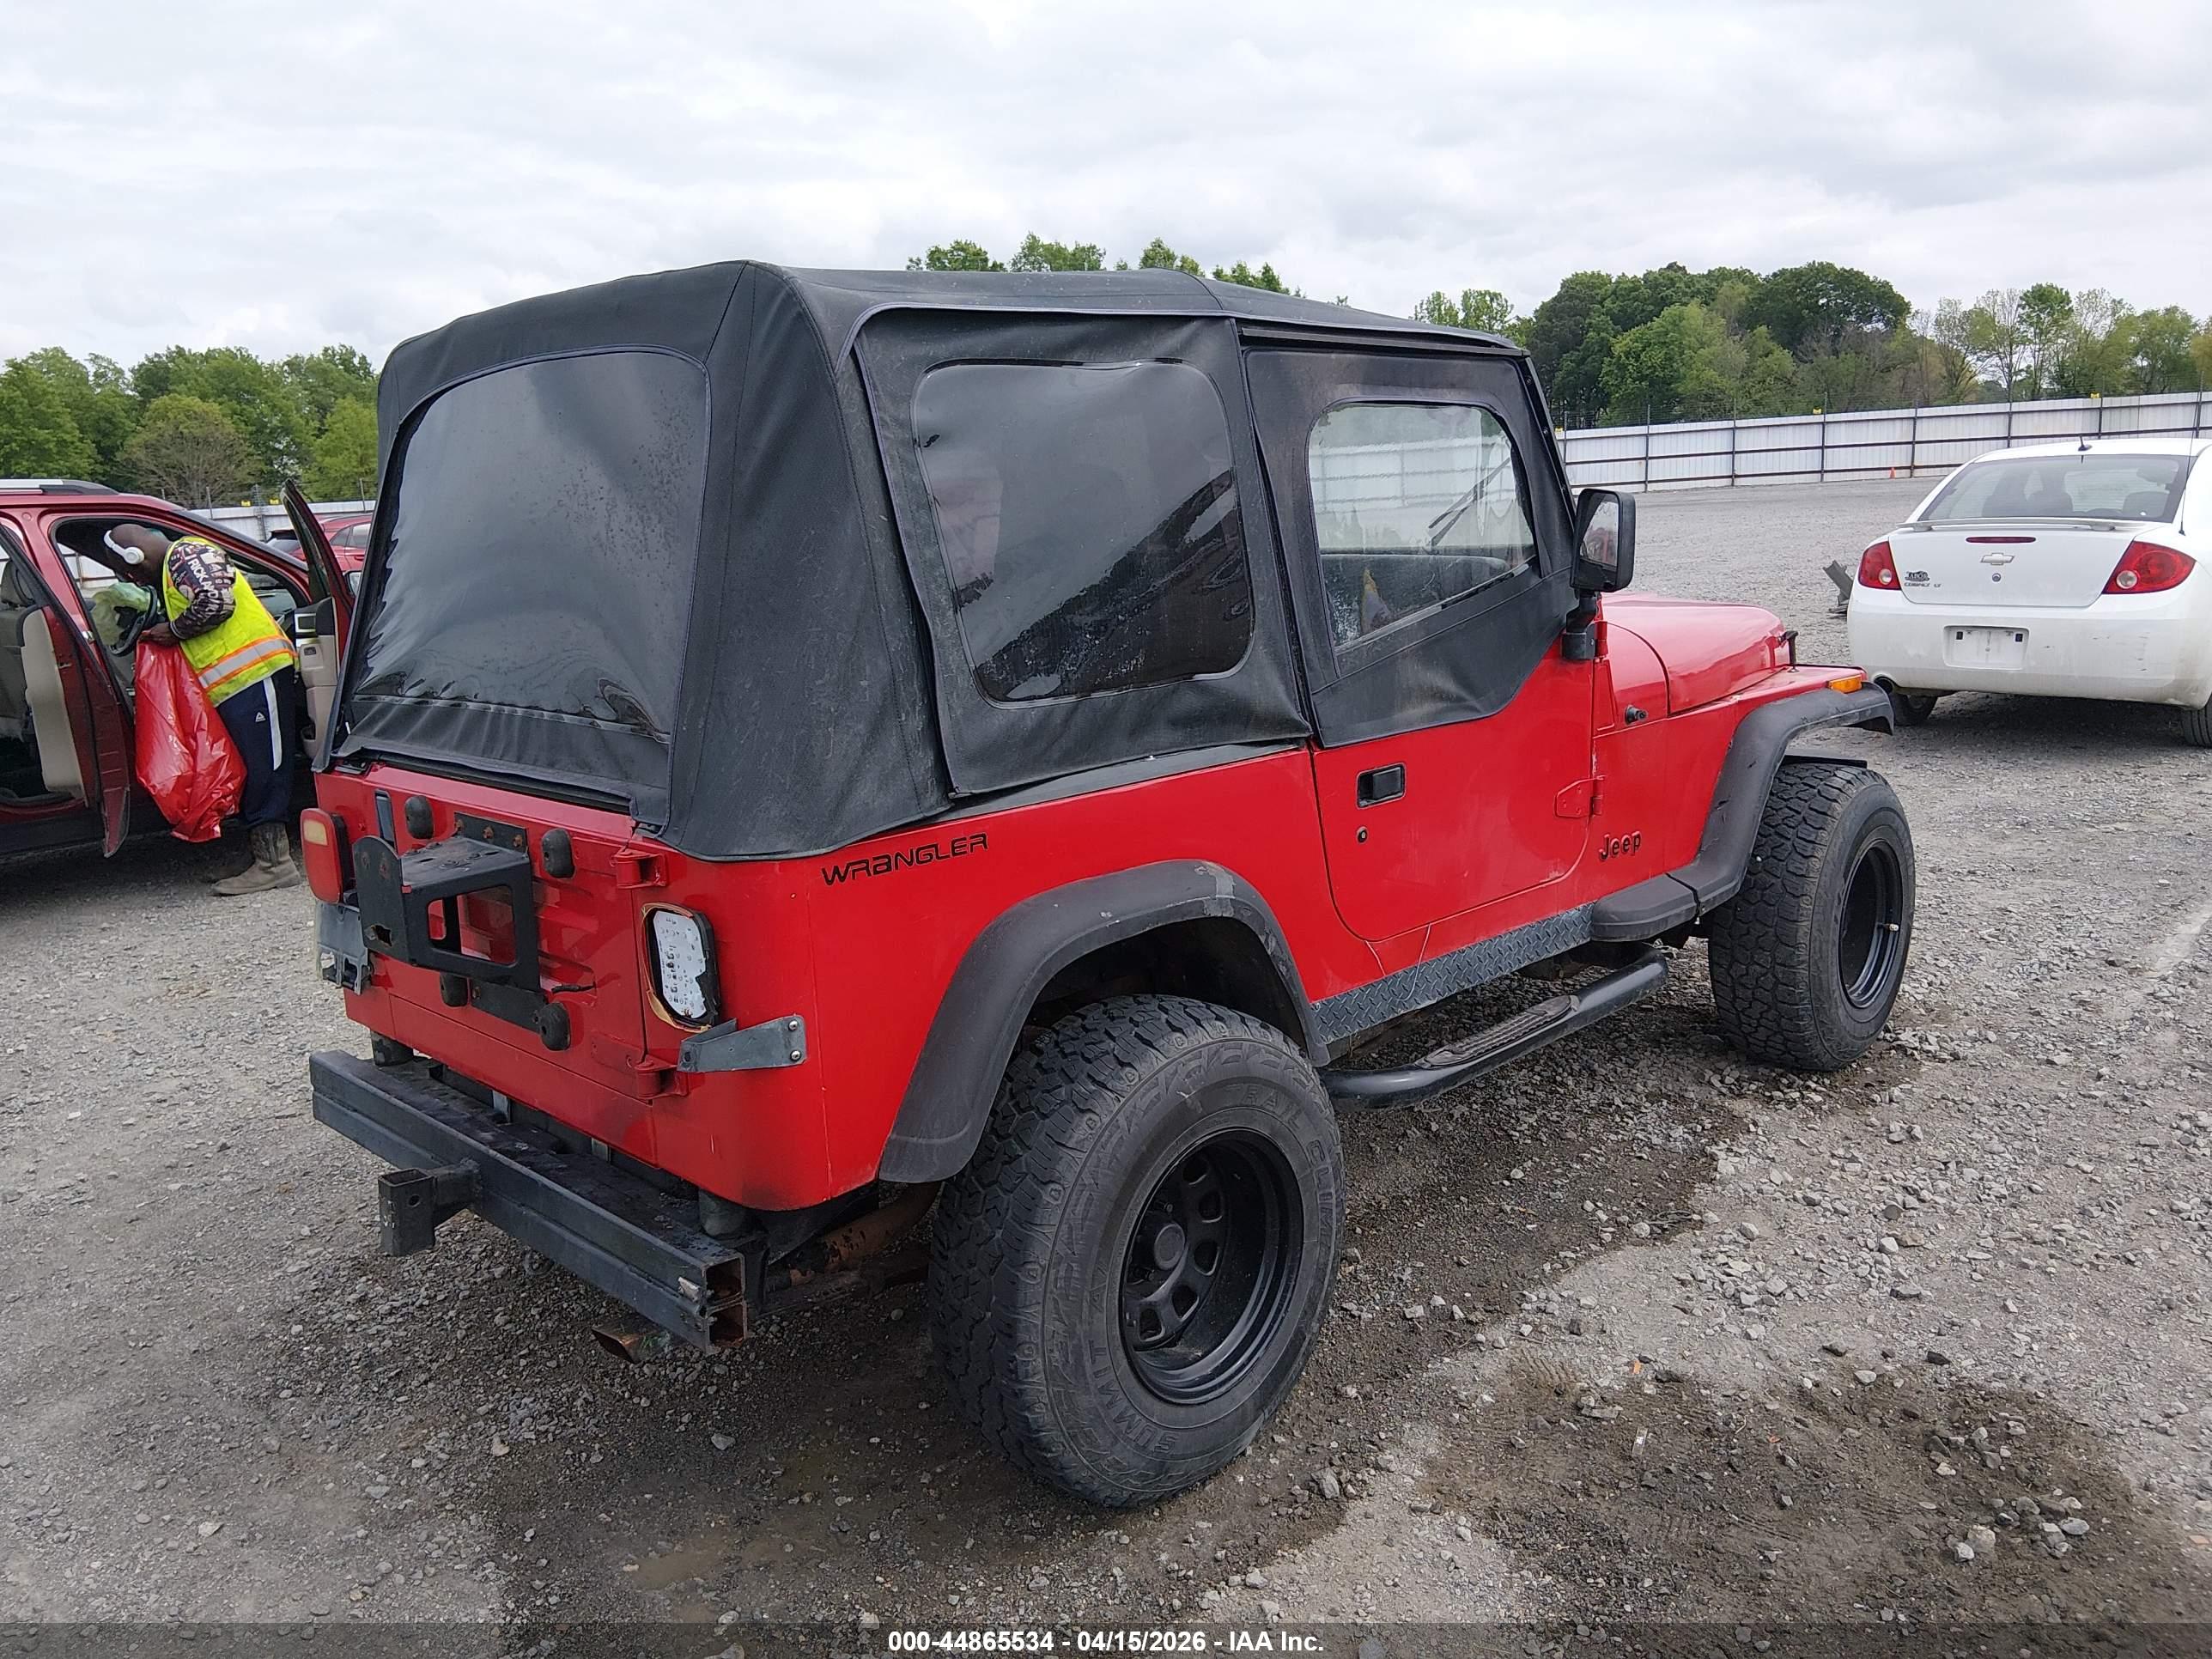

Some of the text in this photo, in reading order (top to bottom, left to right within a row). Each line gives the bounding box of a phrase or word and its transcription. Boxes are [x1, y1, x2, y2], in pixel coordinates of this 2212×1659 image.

[821, 833, 988, 886] WRANGLER
[1599, 831, 1641, 860] Jeep
[1087, 1339, 1180, 1455] SUMMIT
